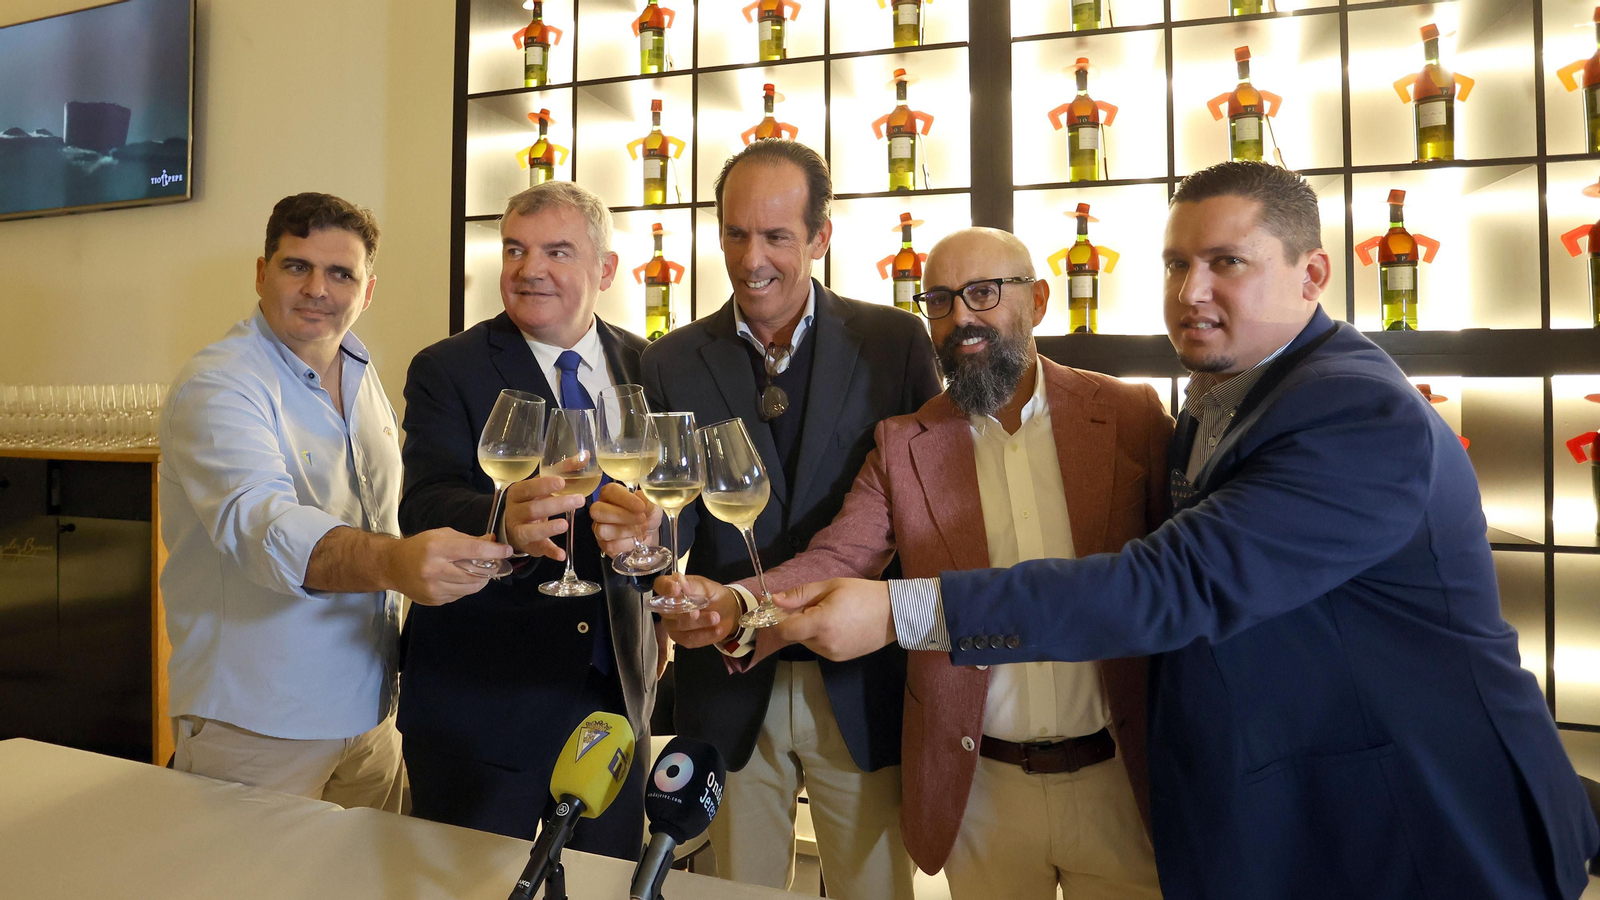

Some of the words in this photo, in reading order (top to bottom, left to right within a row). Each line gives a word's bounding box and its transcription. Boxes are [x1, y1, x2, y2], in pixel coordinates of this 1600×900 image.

[150, 177, 162, 185] TIO
[168, 174, 183, 182] PEPE
[699, 787, 716, 821] Jerez
